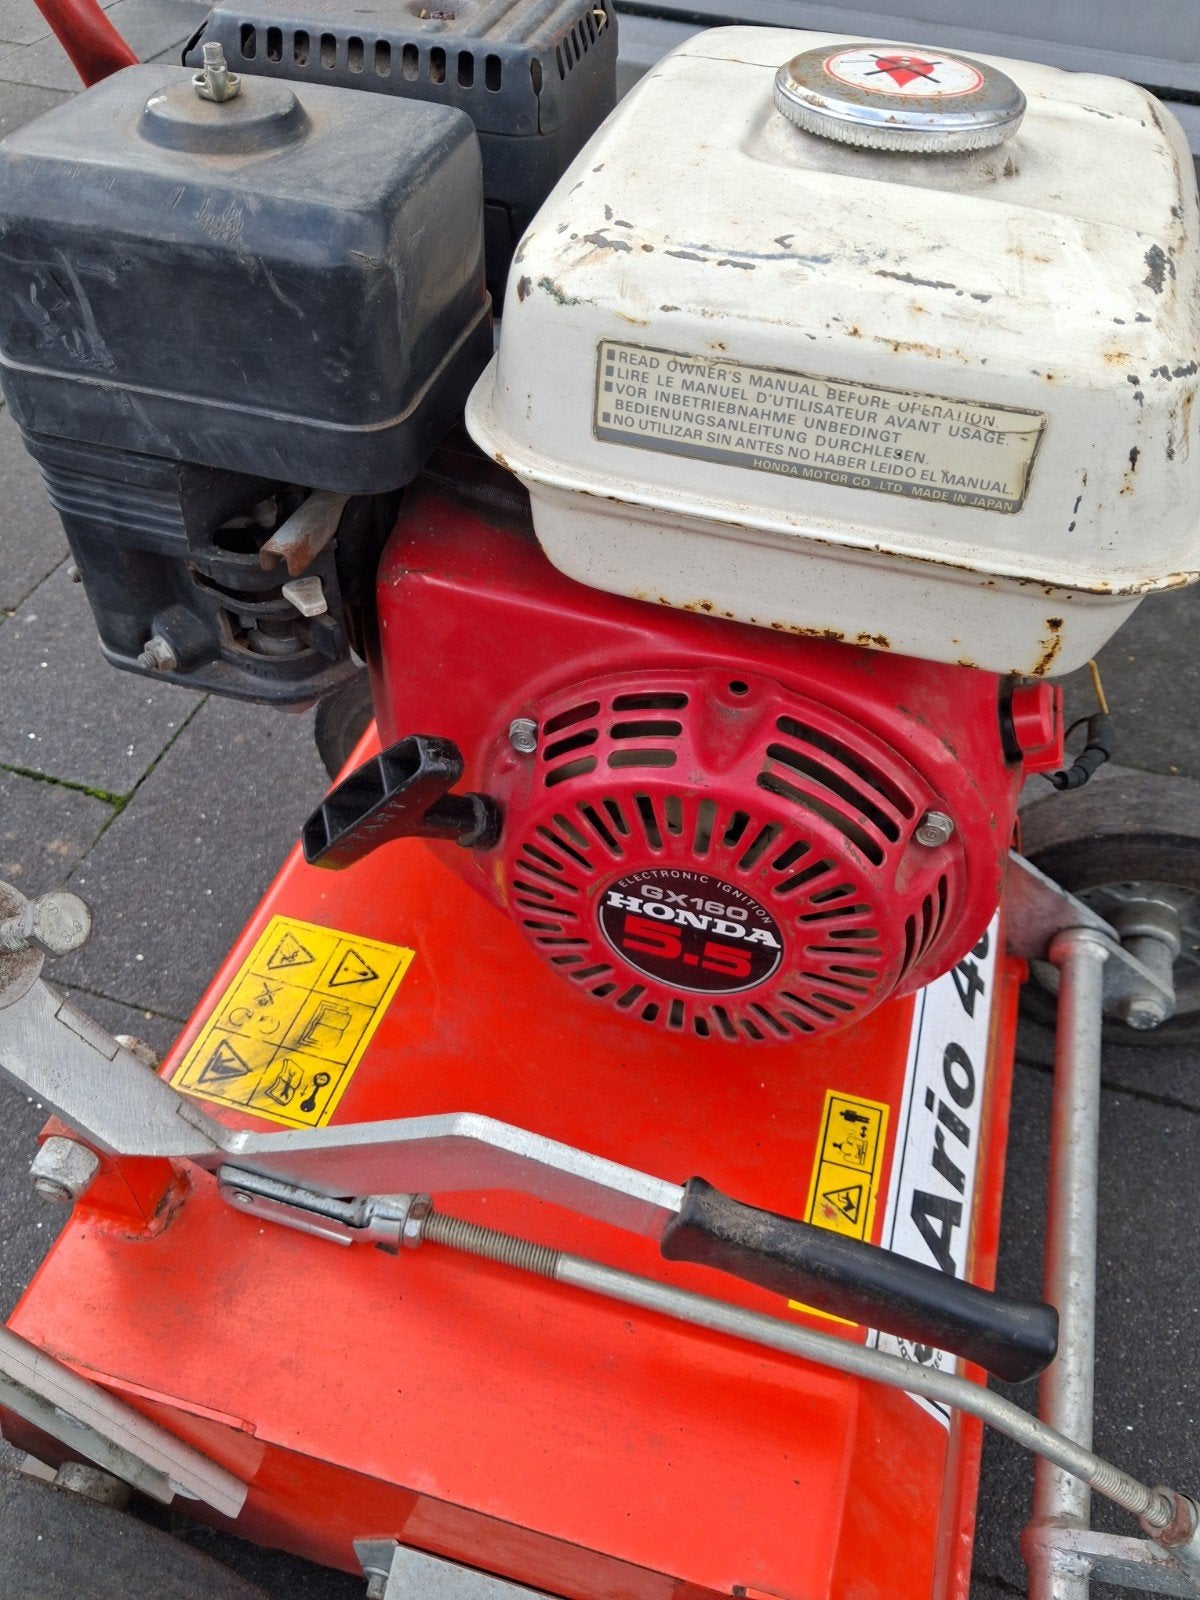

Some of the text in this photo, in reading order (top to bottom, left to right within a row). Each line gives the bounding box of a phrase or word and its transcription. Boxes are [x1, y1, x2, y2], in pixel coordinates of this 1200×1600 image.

[617, 367, 1009, 446] LIRE LE MANUEL D'UTILISATEUR AVANT USAGE.
[618, 351, 660, 370] READ
[667, 359, 742, 384] OWNER'S
[749, 374, 820, 398] MANUAL
[827, 387, 890, 411] BEFORE
[615, 382, 902, 444] VOR INBETRIEBNAHME UNBEDINGT
[615, 398, 930, 465] BEDIENUNGSANLEITUNG DURCHLESEN.
[613, 413, 1014, 496] NO UTILIZAR SIN ANTES NO HABER LEIDO EL MANUAL.
[753, 459, 798, 476] HONDA
[803, 466, 848, 485] MOTOR
[911, 486, 949, 502] MADE
[953, 493, 967, 504] IN
[970, 496, 1013, 513] JAPAN
[606, 890, 782, 949] HONDA
[618, 870, 773, 924] ELECTRONIC IGNITION
[640, 884, 749, 921] GX160
[622, 914, 752, 978] 5.5
[910, 1041, 977, 1275] Ario
